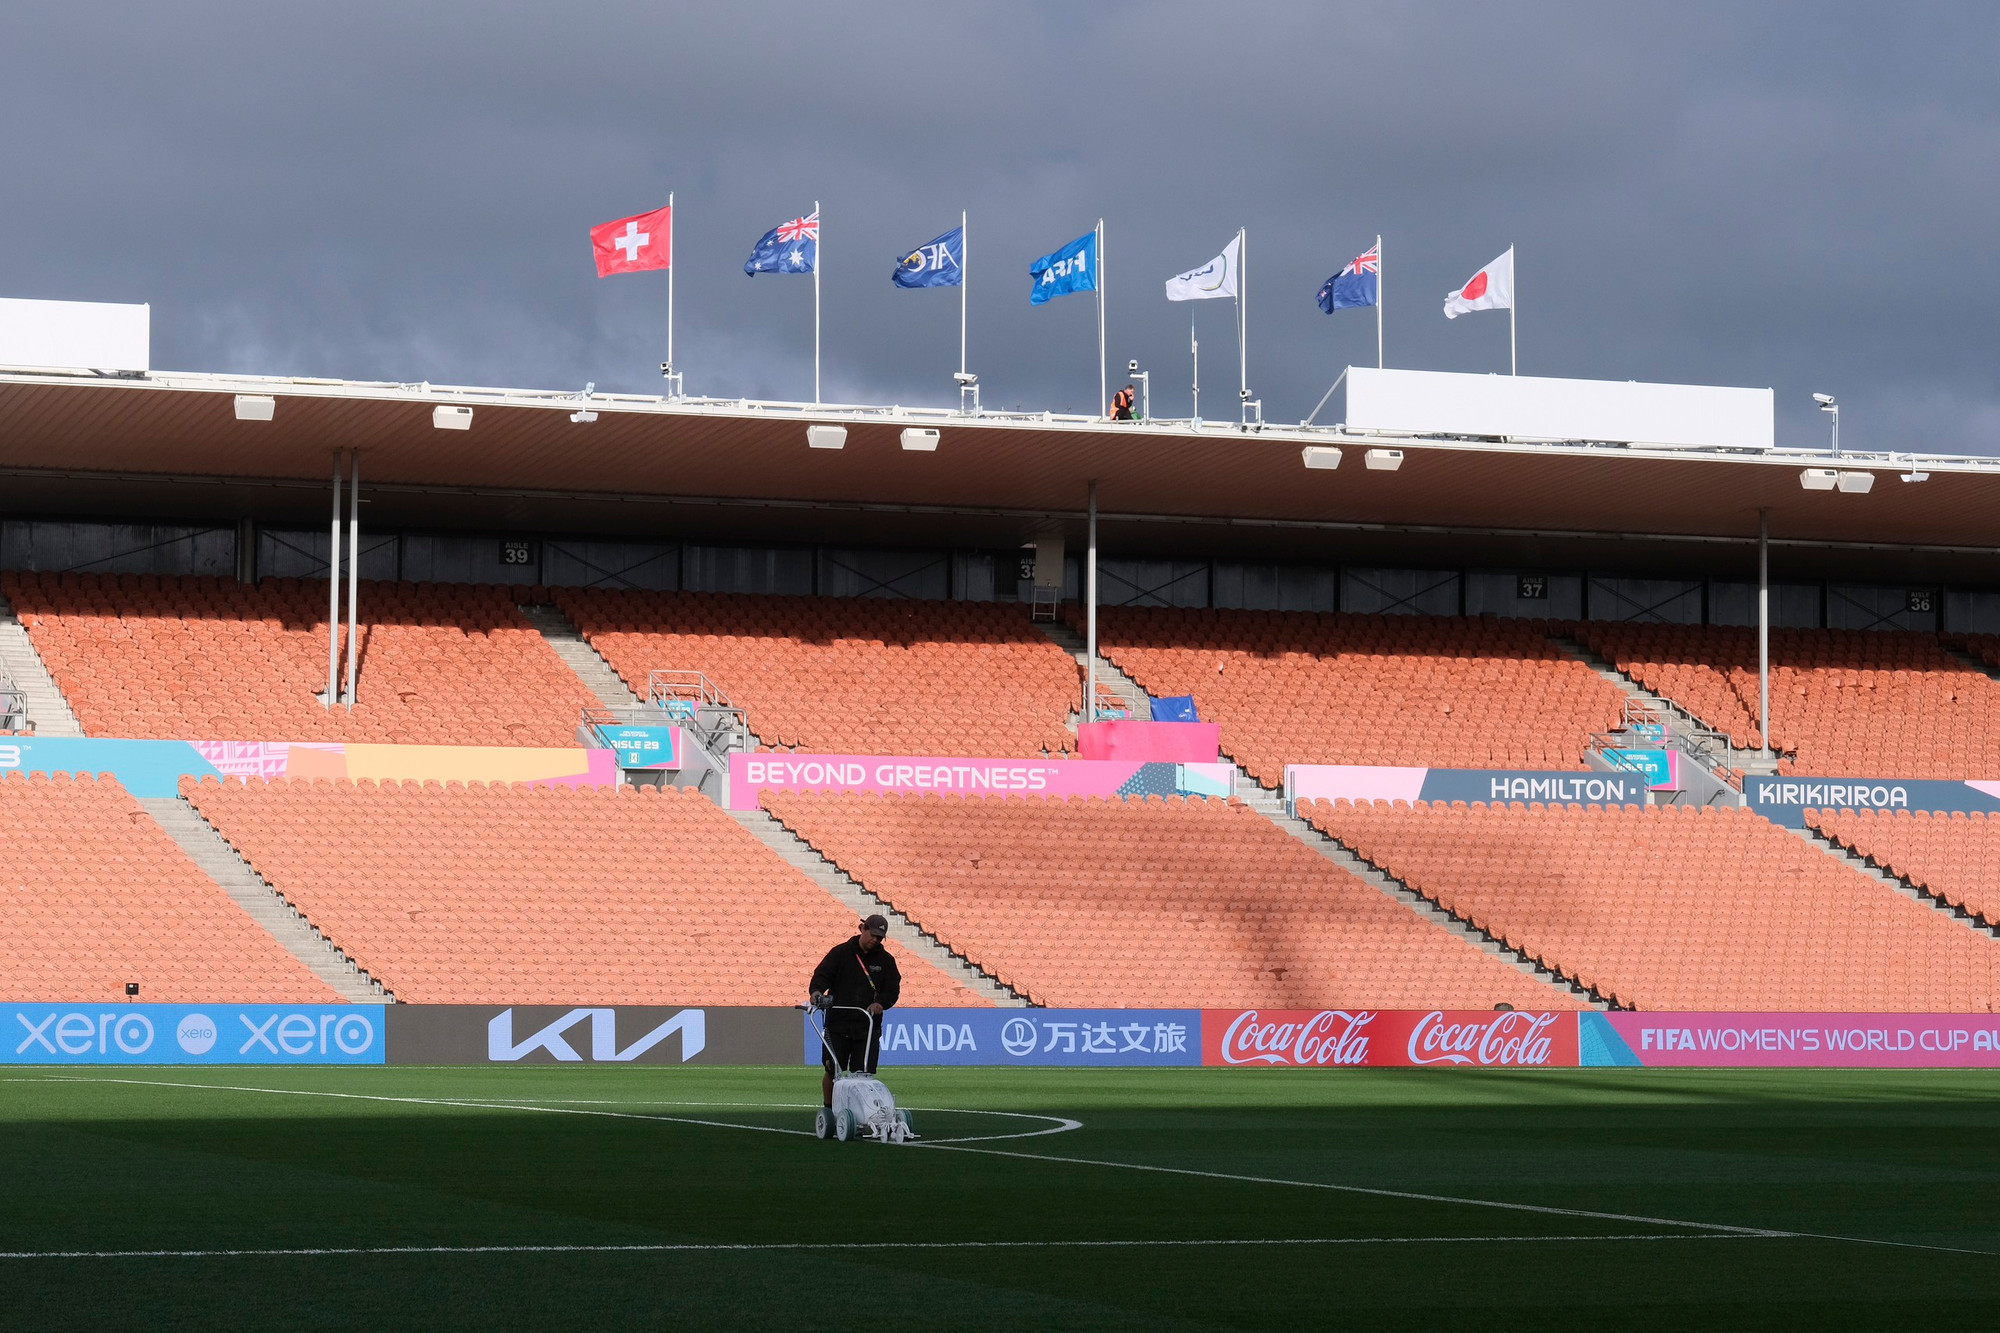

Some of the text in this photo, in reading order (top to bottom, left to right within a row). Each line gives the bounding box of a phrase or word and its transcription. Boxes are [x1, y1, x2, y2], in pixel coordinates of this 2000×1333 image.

[505, 549, 529, 563] 39
[1522, 583, 1543, 597] 37
[1911, 597, 1930, 611] 36
[610, 740, 660, 750] AISLE 29
[747, 762, 866, 784] BEYOND
[1645, 763, 1658, 772] 27
[1491, 778, 1624, 800] HAMILTON
[1759, 783, 1907, 807] KIRIKIRIROA
[16, 1013, 154, 1054] xero
[181, 1029, 212, 1038] xero
[239, 1014, 374, 1054] xero
[1043, 1022, 1187, 1053] 万达文旅
[1221, 1010, 1378, 1065] Coca-Cola
[1407, 1011, 1560, 1065] Coca-Cola
[1641, 1029, 1694, 1050] FIFA
[1698, 1029, 1819, 1051] WOMEN'S
[1825, 1029, 1915, 1051] WORLD
[1920, 1029, 1969, 1051] CUP
